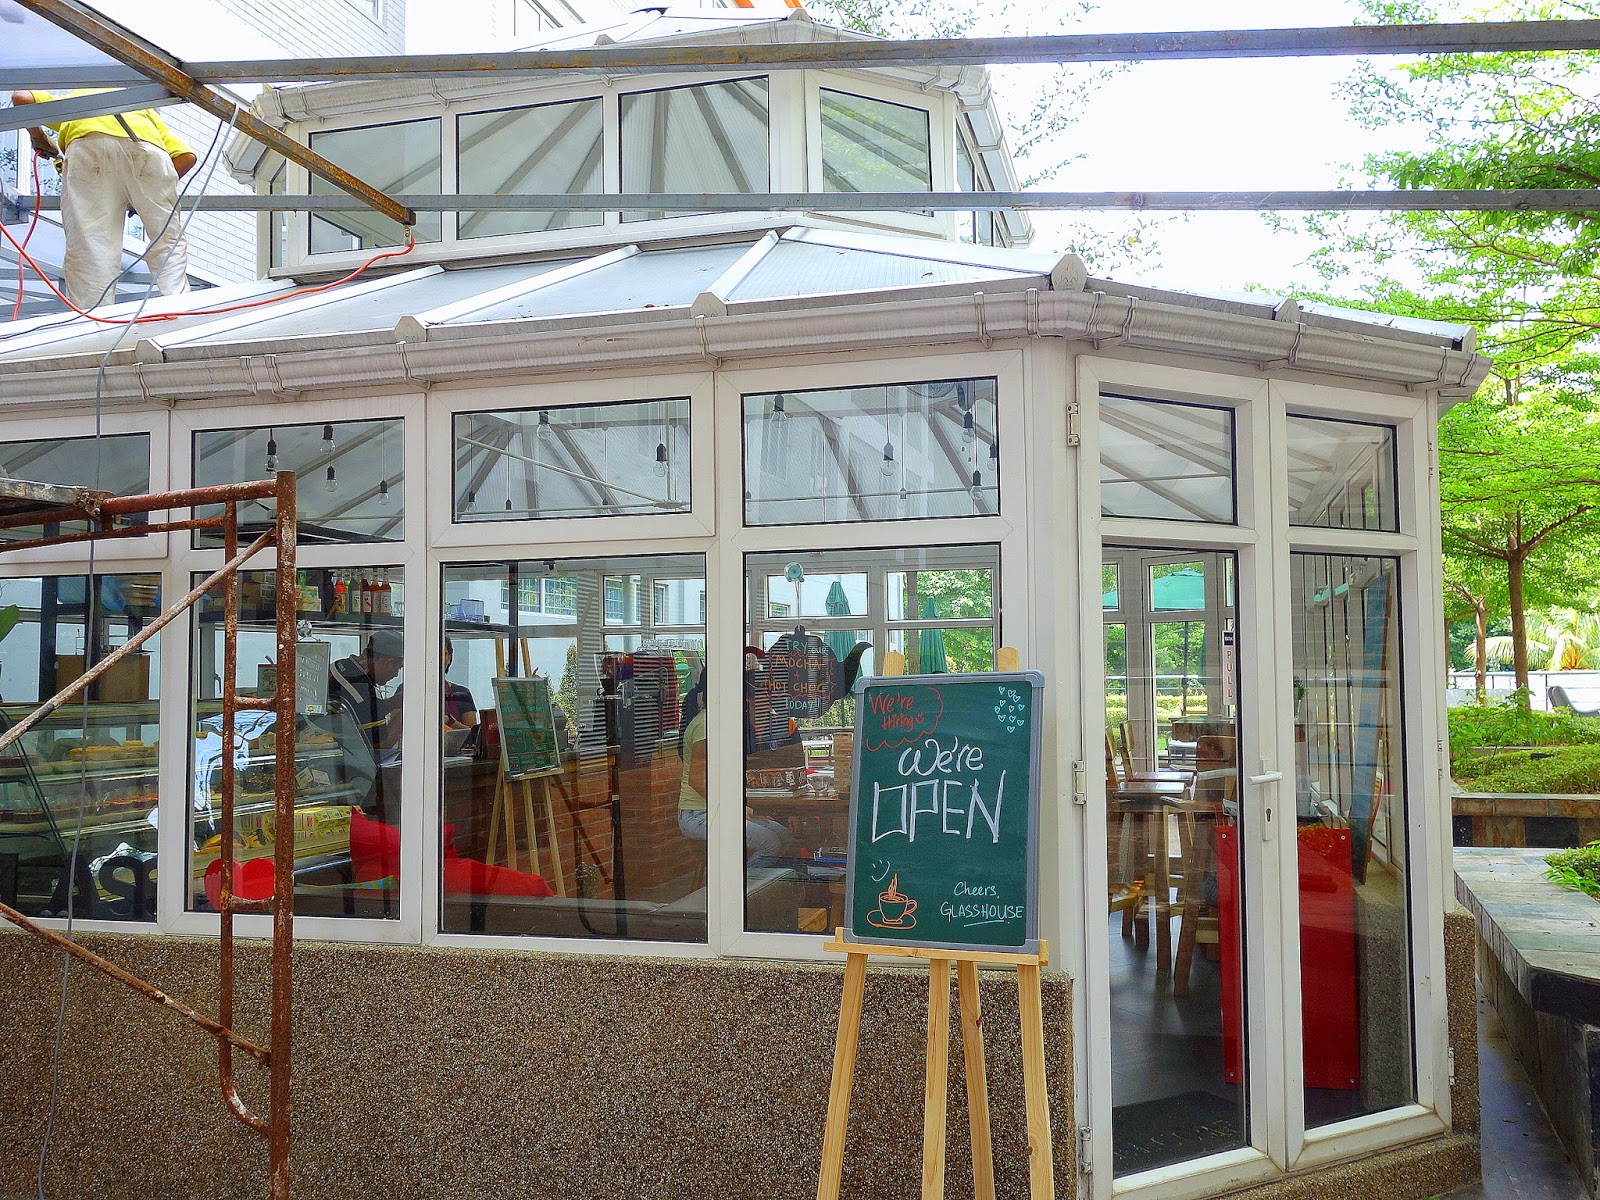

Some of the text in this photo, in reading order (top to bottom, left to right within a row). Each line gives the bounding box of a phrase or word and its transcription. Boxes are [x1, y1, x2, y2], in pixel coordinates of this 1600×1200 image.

[786, 640, 809, 654] TRY
[775, 656, 825, 669] MOCHA
[1226, 650, 1234, 698] PULL
[768, 681, 826, 693] HOT CHOC
[869, 693, 915, 713] We're
[882, 715, 915, 733] Hiring
[898, 736, 984, 777] We're
[872, 770, 1007, 843] OPEN
[940, 901, 1025, 922] GLASSHOUSE
